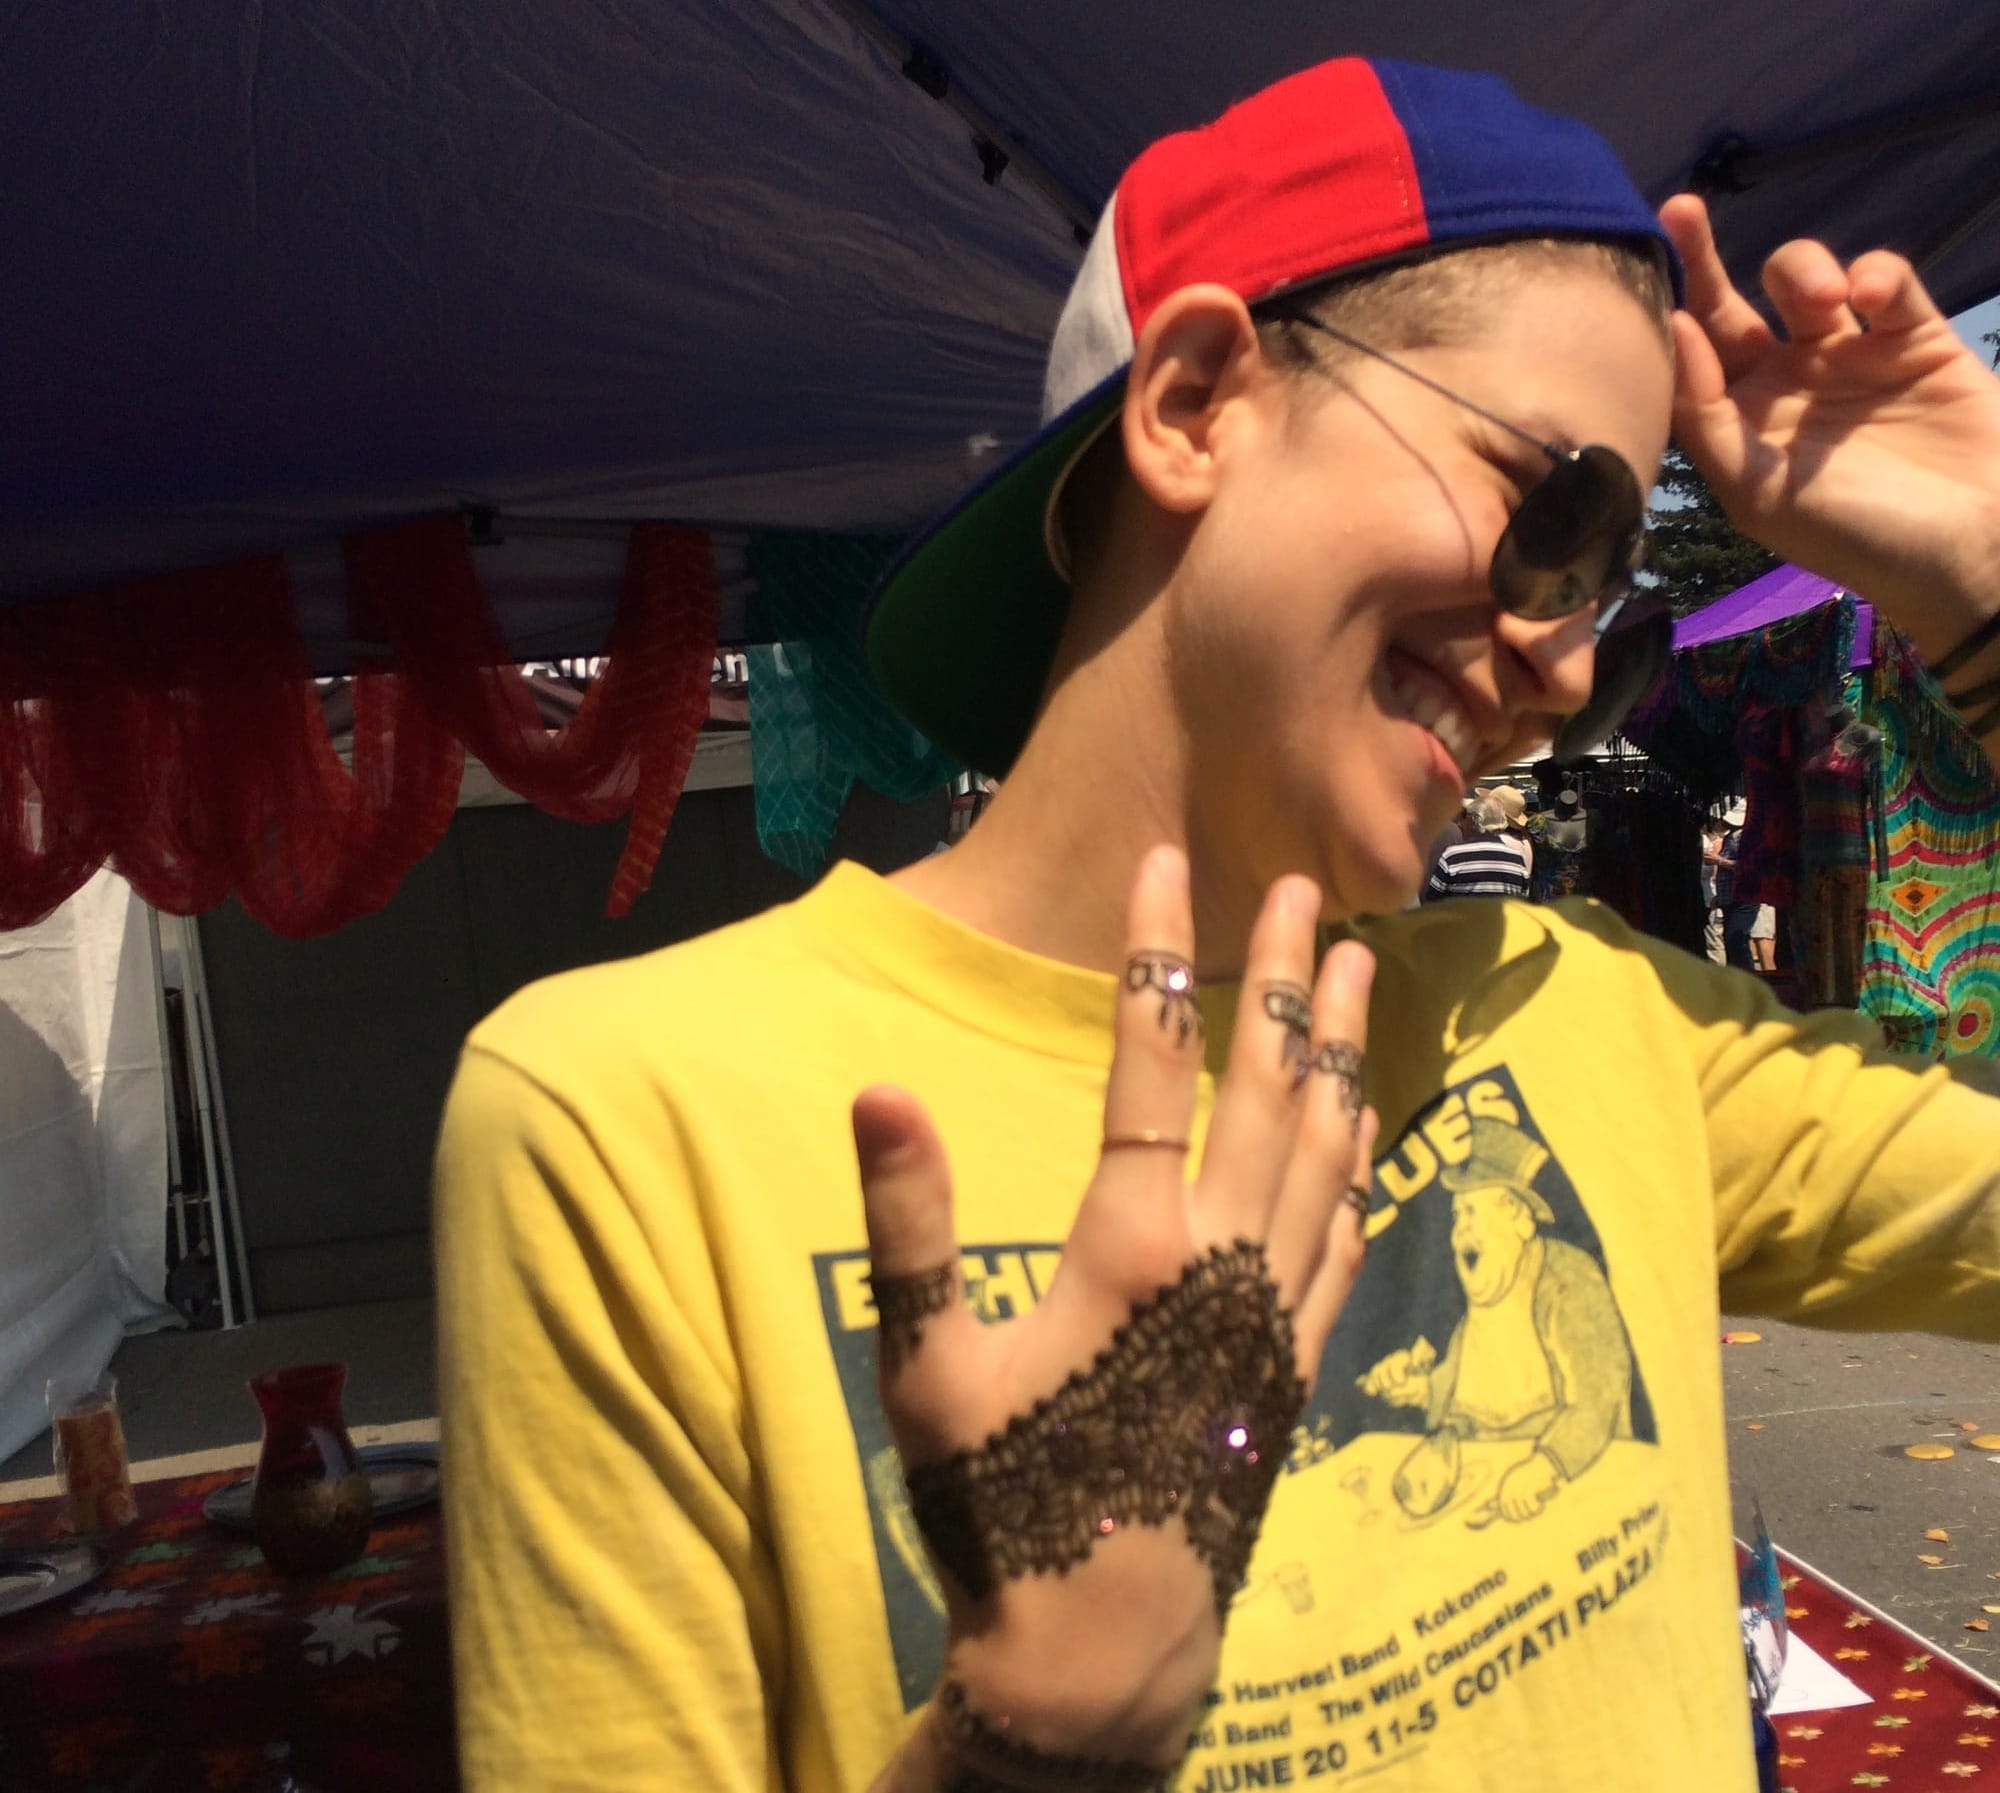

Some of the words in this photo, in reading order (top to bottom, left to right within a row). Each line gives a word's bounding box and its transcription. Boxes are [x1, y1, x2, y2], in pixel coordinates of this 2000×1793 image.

[1224, 1716, 1292, 1746] Band
[1318, 1698, 1365, 1725] The
[1370, 1665, 1421, 1705] Wild
[1425, 1582, 1553, 1676] Caucasians
[1341, 1640, 1400, 1677] Band
[1413, 1568, 1508, 1638] Kokomo
[1576, 1534, 1619, 1572] Billy
[1194, 1754, 1293, 1793] JUNE
[1303, 1741, 1347, 1778] 20
[1365, 1699, 1438, 1755] 11-5
[1453, 1609, 1570, 1709] COTATI
